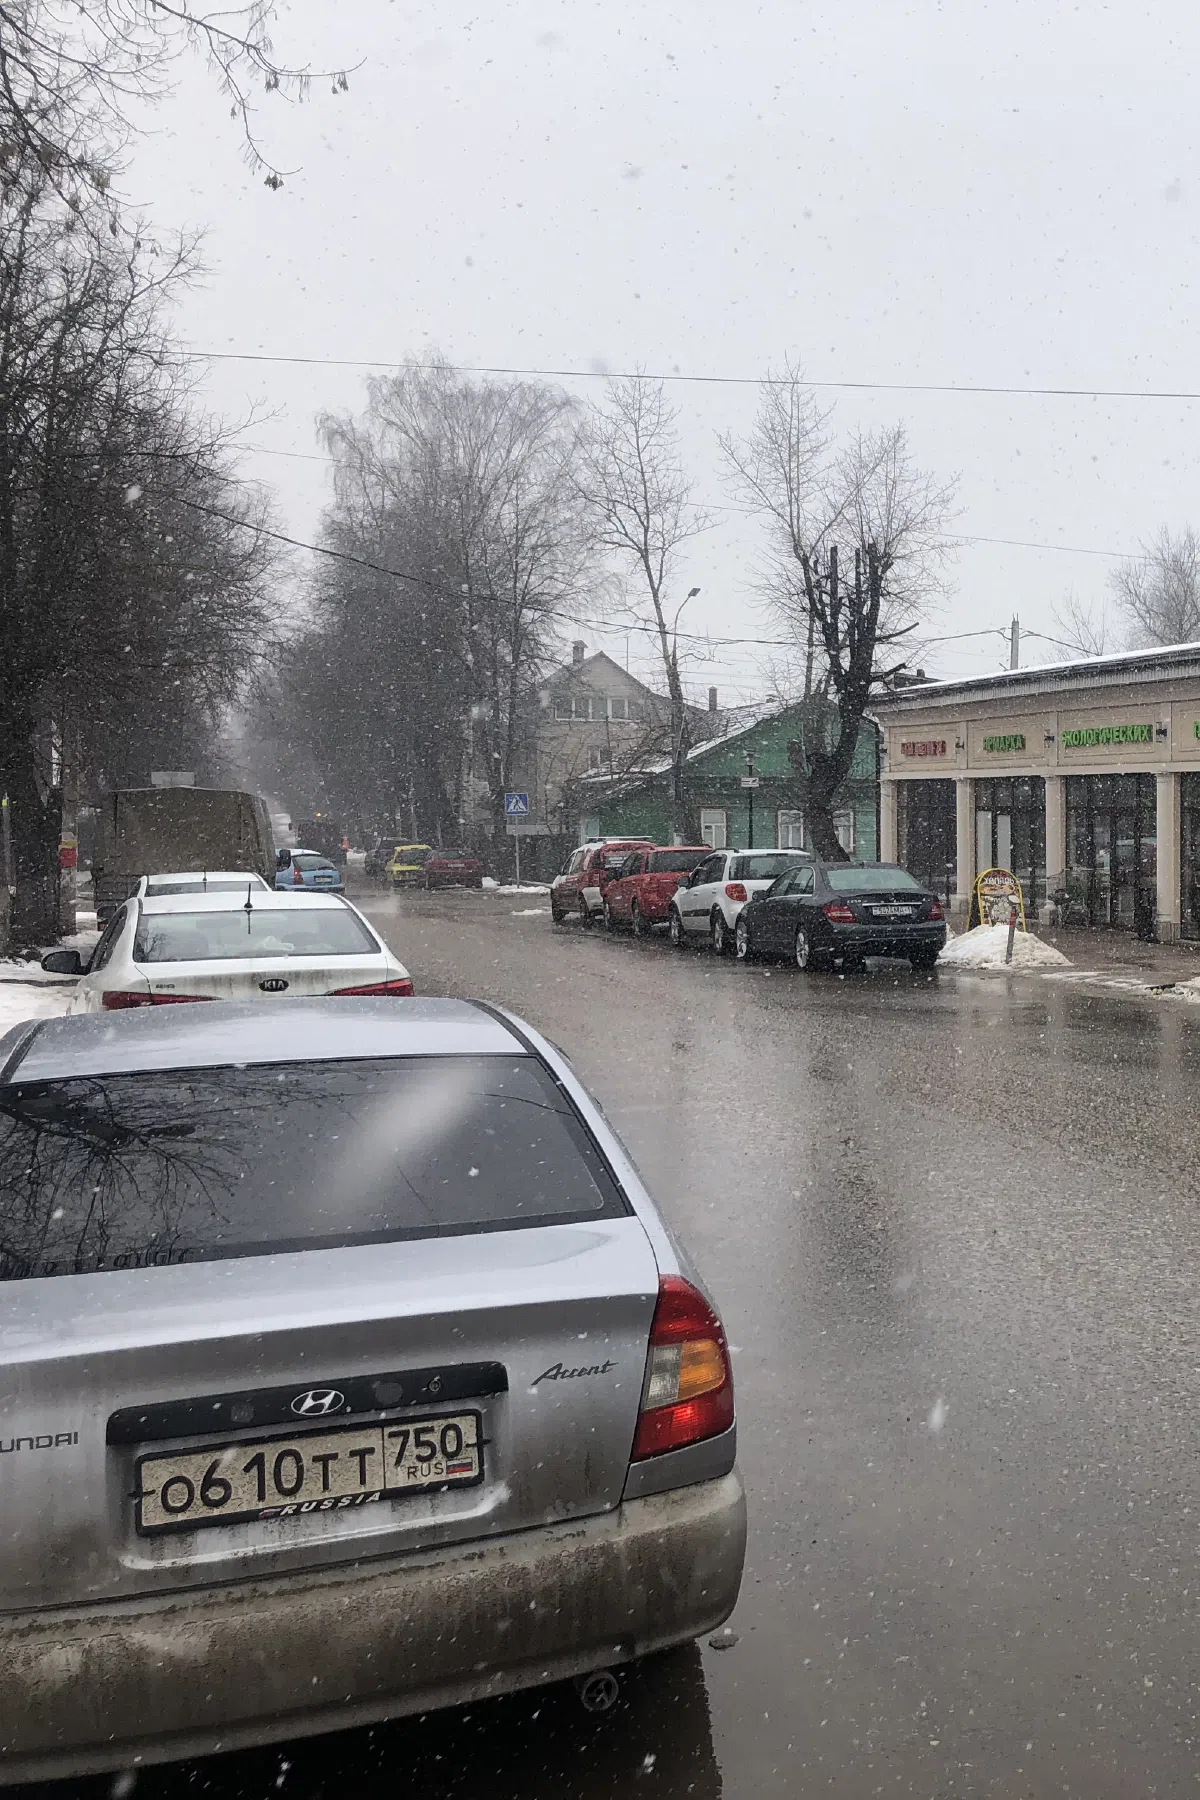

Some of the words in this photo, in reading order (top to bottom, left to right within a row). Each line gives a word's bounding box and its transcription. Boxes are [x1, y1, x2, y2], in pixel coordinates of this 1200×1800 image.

[983, 735, 1025, 752] ЯРМАРКА
[1062, 725, 1152, 746] ЭКОЛОГИЧЕСКИХ
[264, 981, 286, 990] KIA
[531, 1359, 619, 1386] Accent
[387, 1423, 462, 1468] 750
[407, 1463, 444, 1479] RUS
[279, 1491, 382, 1517] RUSSIA
